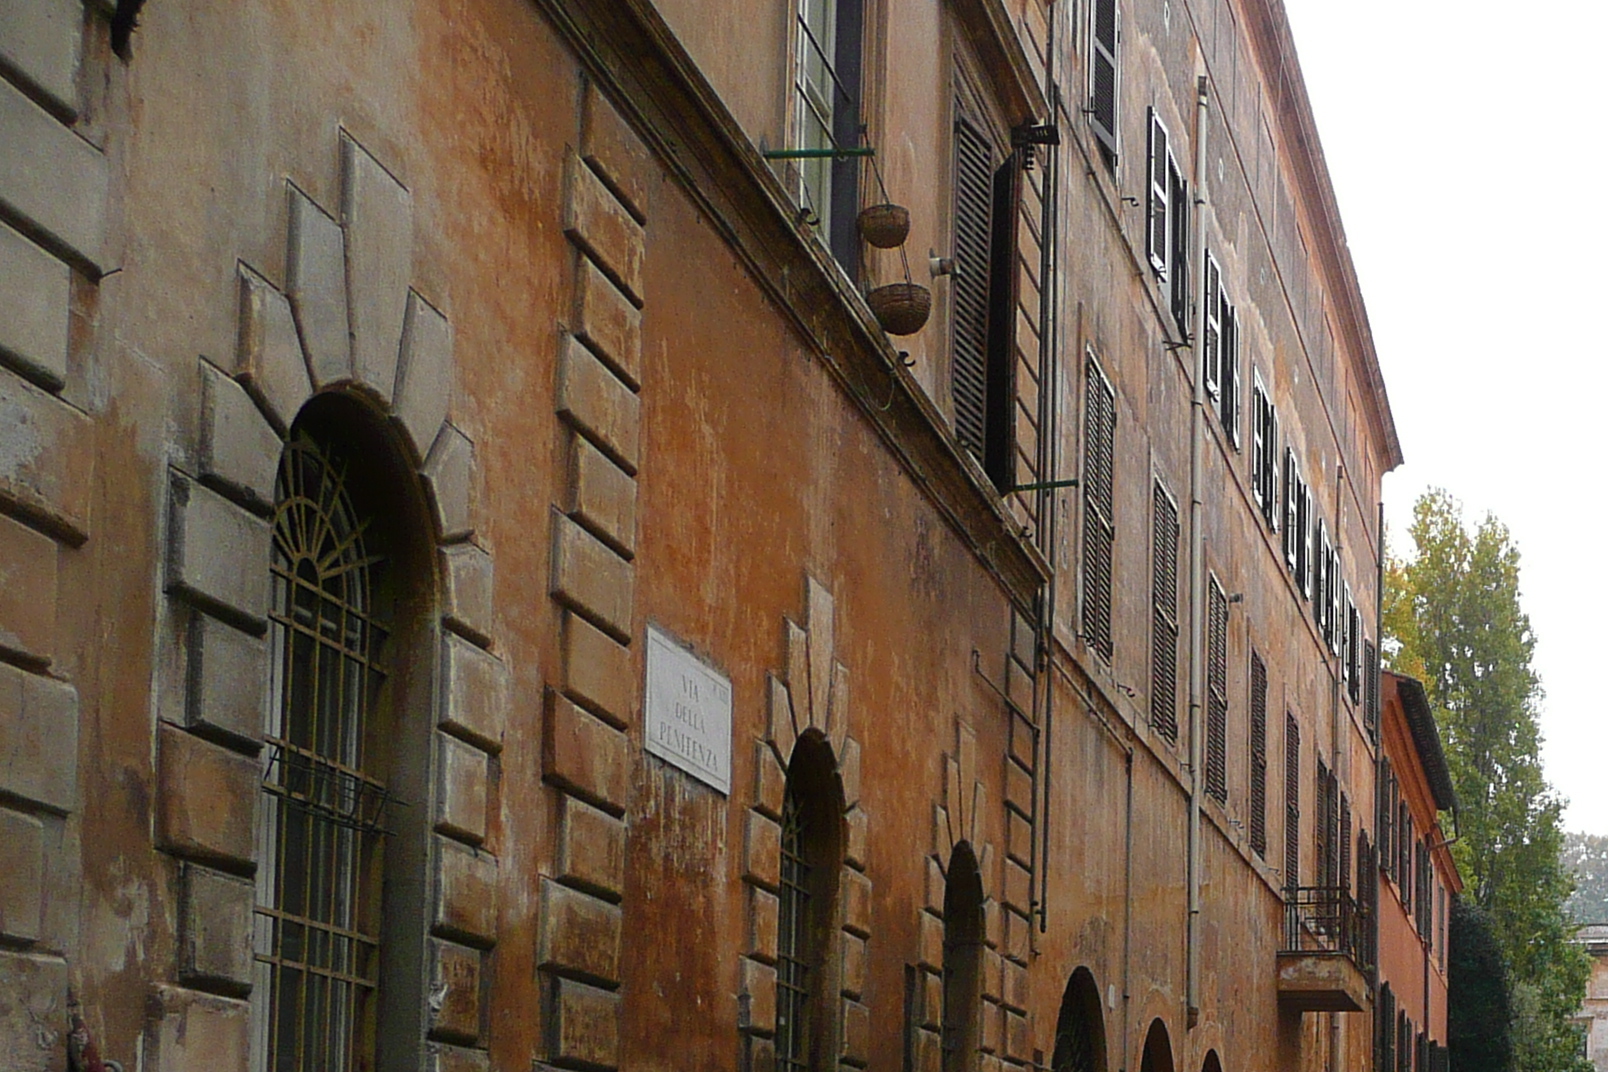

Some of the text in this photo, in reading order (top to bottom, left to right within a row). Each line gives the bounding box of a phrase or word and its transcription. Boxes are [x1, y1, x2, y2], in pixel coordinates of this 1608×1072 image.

[682, 674, 699, 703] VIA
[675, 701, 706, 735] DELLA
[660, 721, 719, 772] PENITENZA
